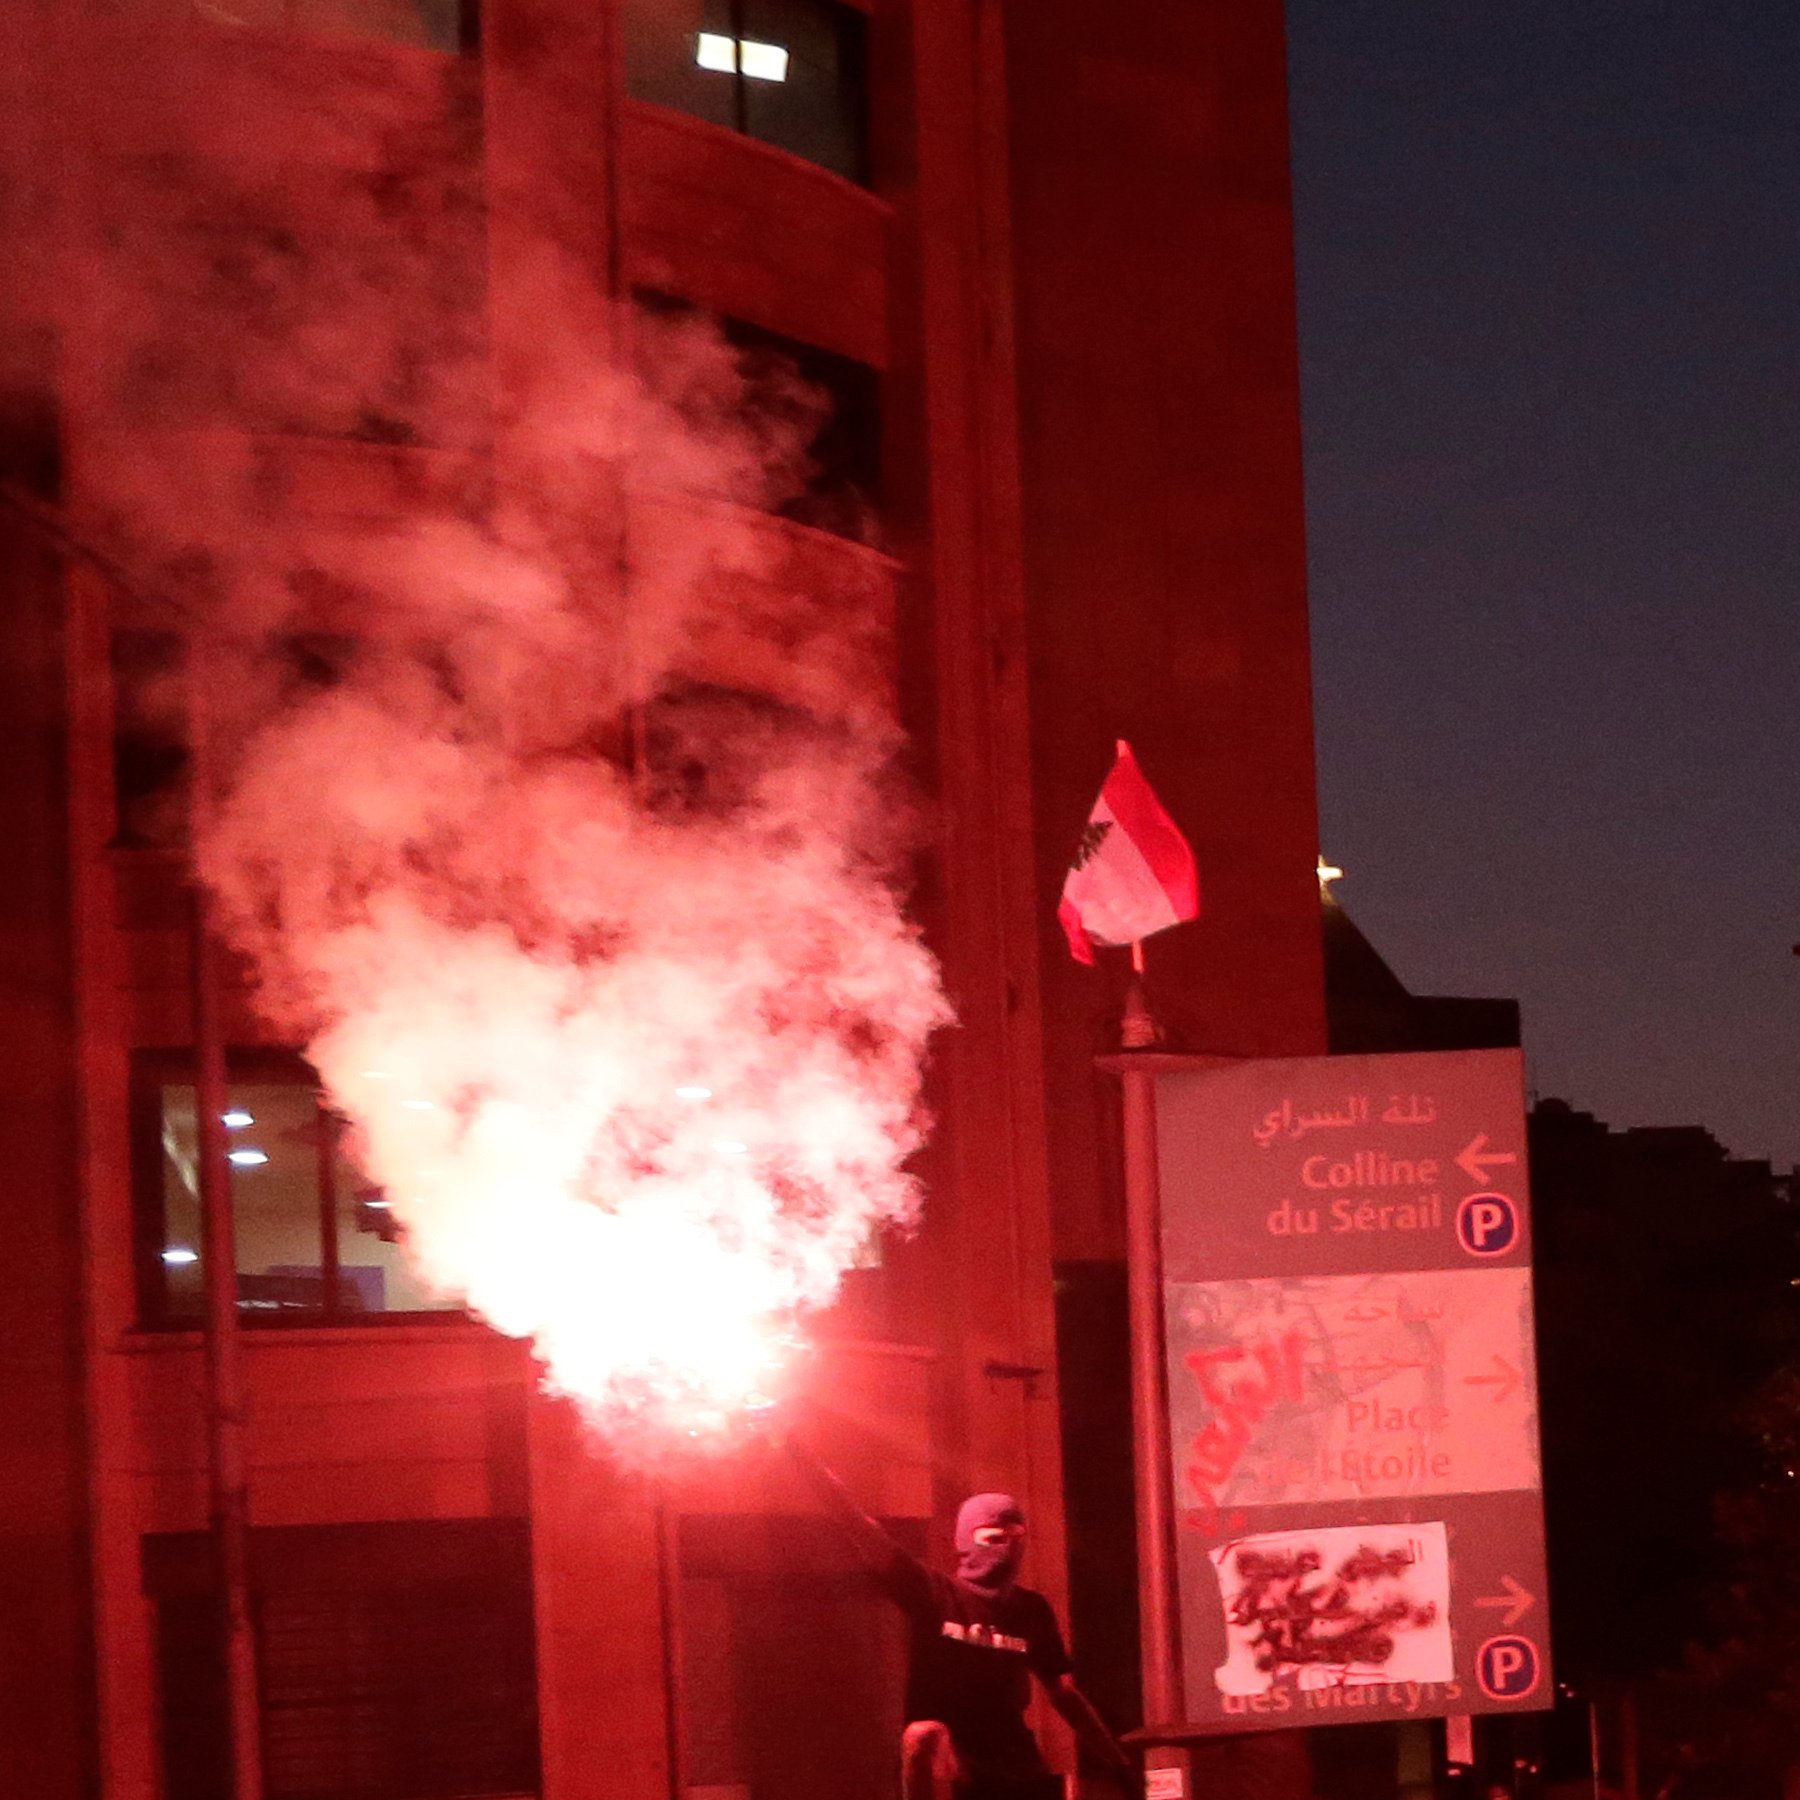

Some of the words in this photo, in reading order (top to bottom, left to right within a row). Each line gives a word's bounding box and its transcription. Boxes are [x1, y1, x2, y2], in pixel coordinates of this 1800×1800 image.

[1253, 1094, 1370, 1148] السراي
[1381, 1093, 1437, 1124] تلة
[1301, 1150, 1440, 1190] Colline
[1267, 1198, 1318, 1236] du
[1330, 1193, 1442, 1233] Sérail
[1471, 1203, 1504, 1247] P
[1346, 1399, 1450, 1435] Place
[1491, 1646, 1524, 1690] P
